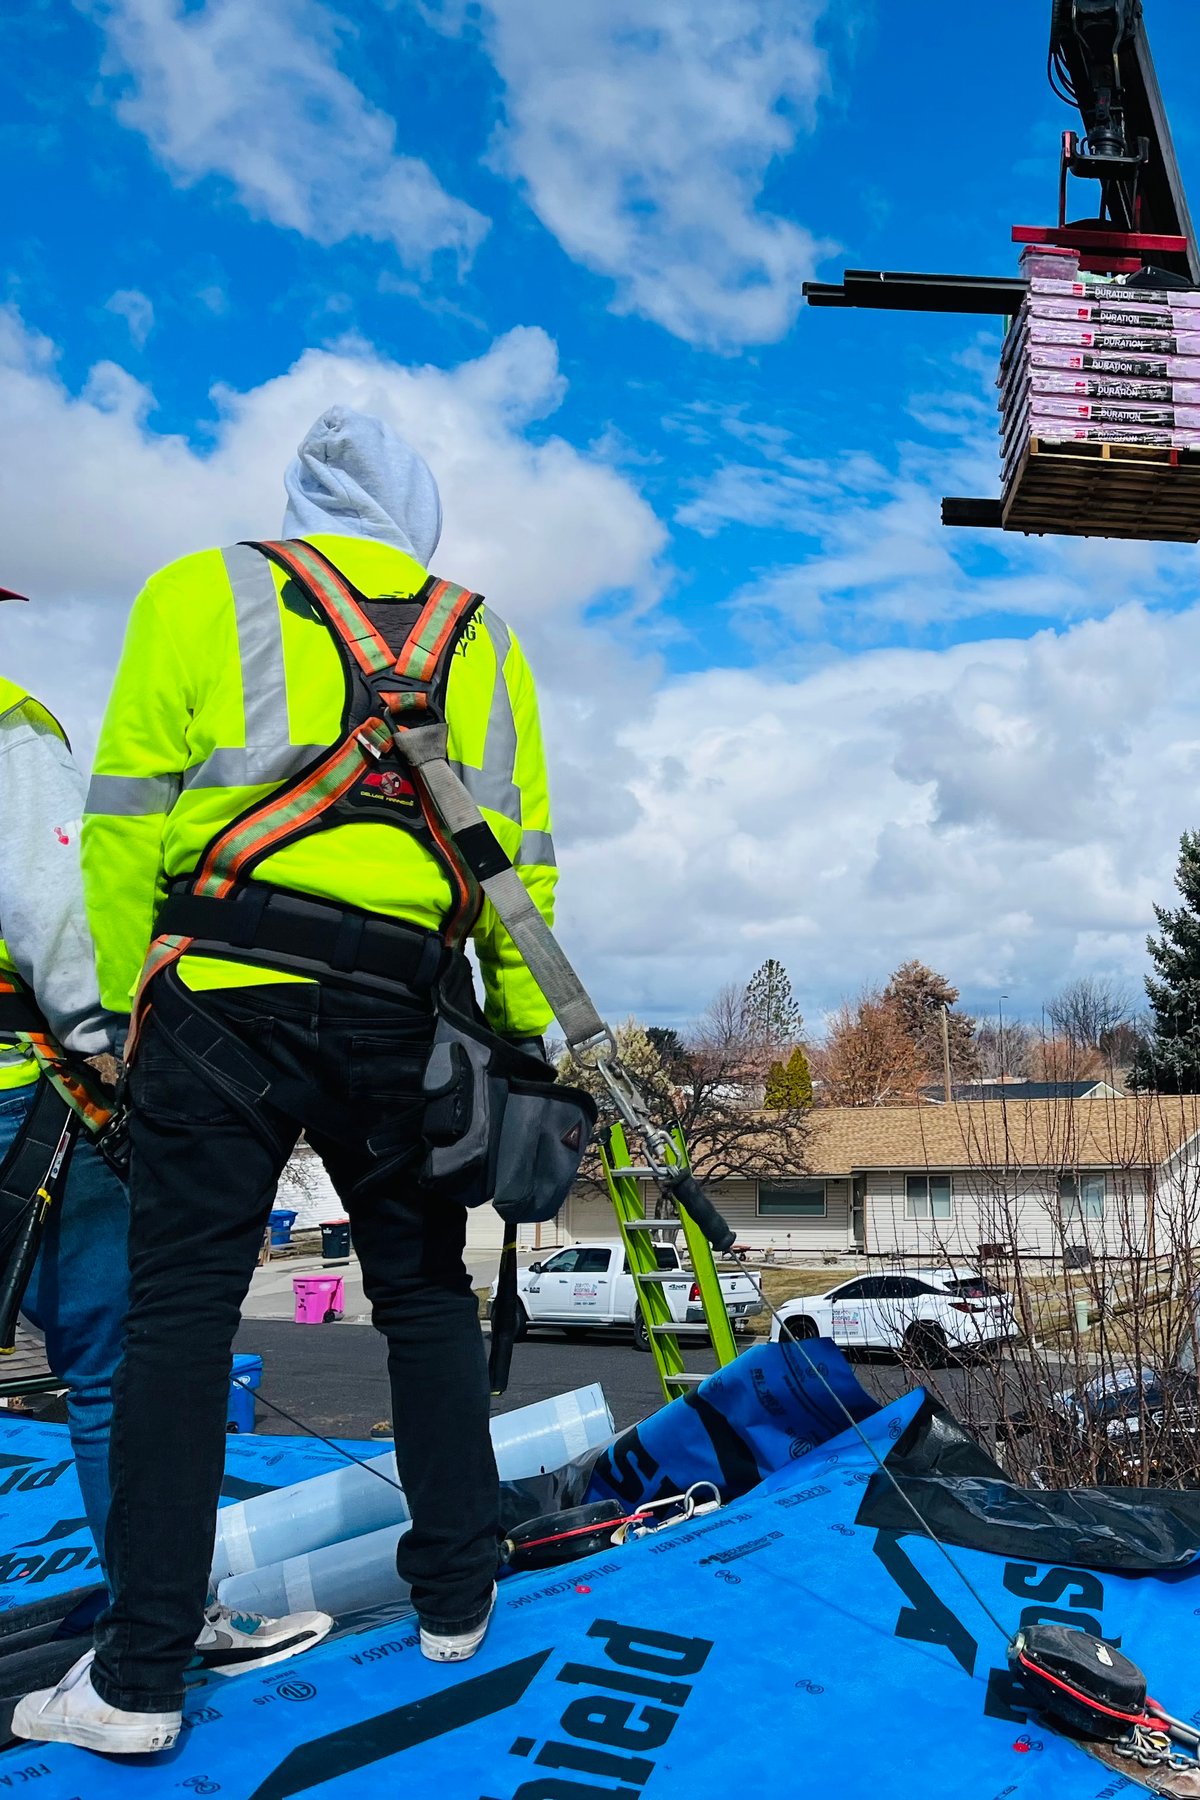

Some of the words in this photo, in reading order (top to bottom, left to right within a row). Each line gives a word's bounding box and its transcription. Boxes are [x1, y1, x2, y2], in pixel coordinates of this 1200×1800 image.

[1094, 288, 1135, 299] DURATION
[1100, 312, 1140, 323] DURATION
[1103, 337, 1143, 348] DURATION
[1092, 360, 1132, 371] DURATION
[1097, 386, 1138, 397] DURATION
[1101, 409, 1141, 420] DURATION
[363, 1641, 404, 1662] CLASS
[351, 1654, 364, 1665] A
[253, 1694, 276, 1706] US
[13, 1763, 52, 1783] FBC
